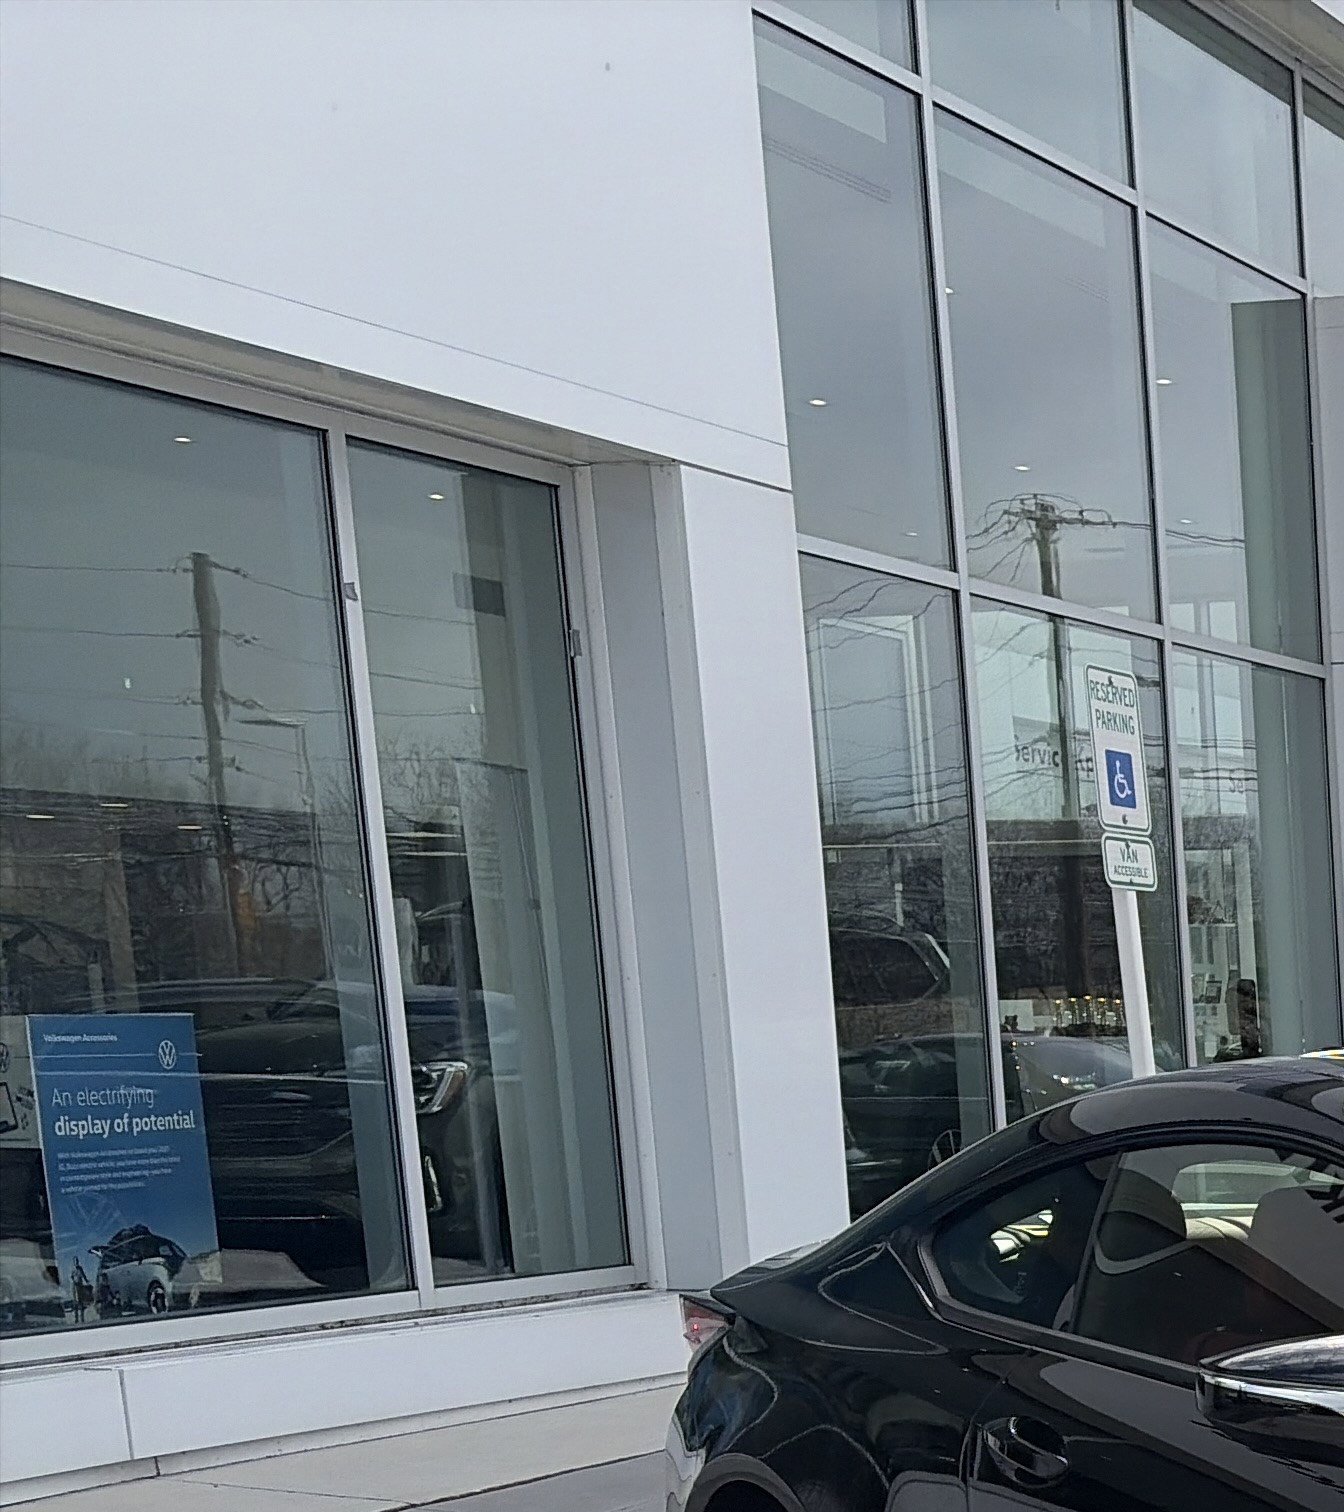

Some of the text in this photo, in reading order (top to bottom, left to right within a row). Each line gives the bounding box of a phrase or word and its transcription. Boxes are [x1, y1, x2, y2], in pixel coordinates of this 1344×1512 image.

[1090, 679, 1135, 708] RESERVED
[1095, 708, 1135, 735] PARKING
[1119, 847, 1138, 863] VAN
[1113, 865, 1148, 878] ACCESSIBLE
[43, 1033, 81, 1043] Volkswagen
[52, 1085, 155, 1109] An electrifying
[54, 1110, 196, 1139] display of potential
